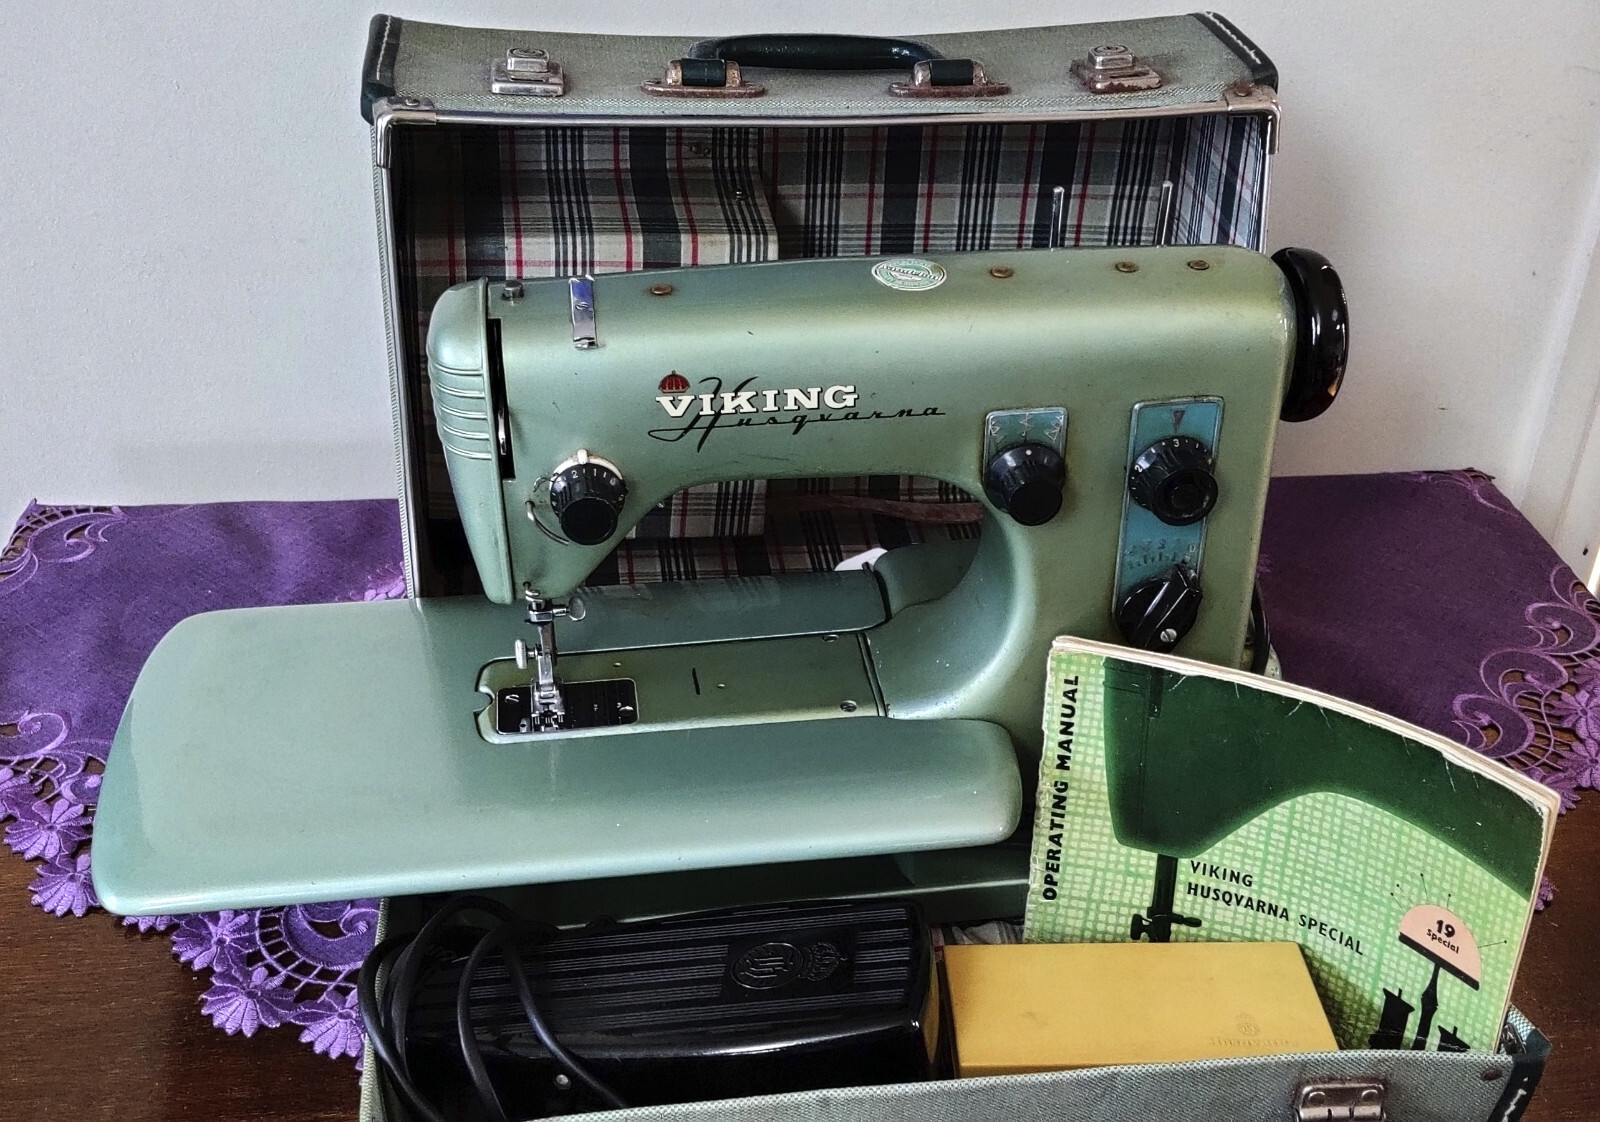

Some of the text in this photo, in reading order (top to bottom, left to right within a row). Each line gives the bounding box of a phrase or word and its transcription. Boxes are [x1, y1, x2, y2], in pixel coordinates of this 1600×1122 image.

[647, 376, 946, 453] Husqvarna
[655, 385, 860, 418] VIKING
[1173, 438, 1180, 448] 3
[571, 470, 579, 479] 2
[1042, 675, 1079, 901] OPERATING MANUAL
[1190, 860, 1253, 887] VIKING
[1187, 881, 1363, 955] HUSQVARNA SPECIAL
[1436, 919, 1456, 938] 19
